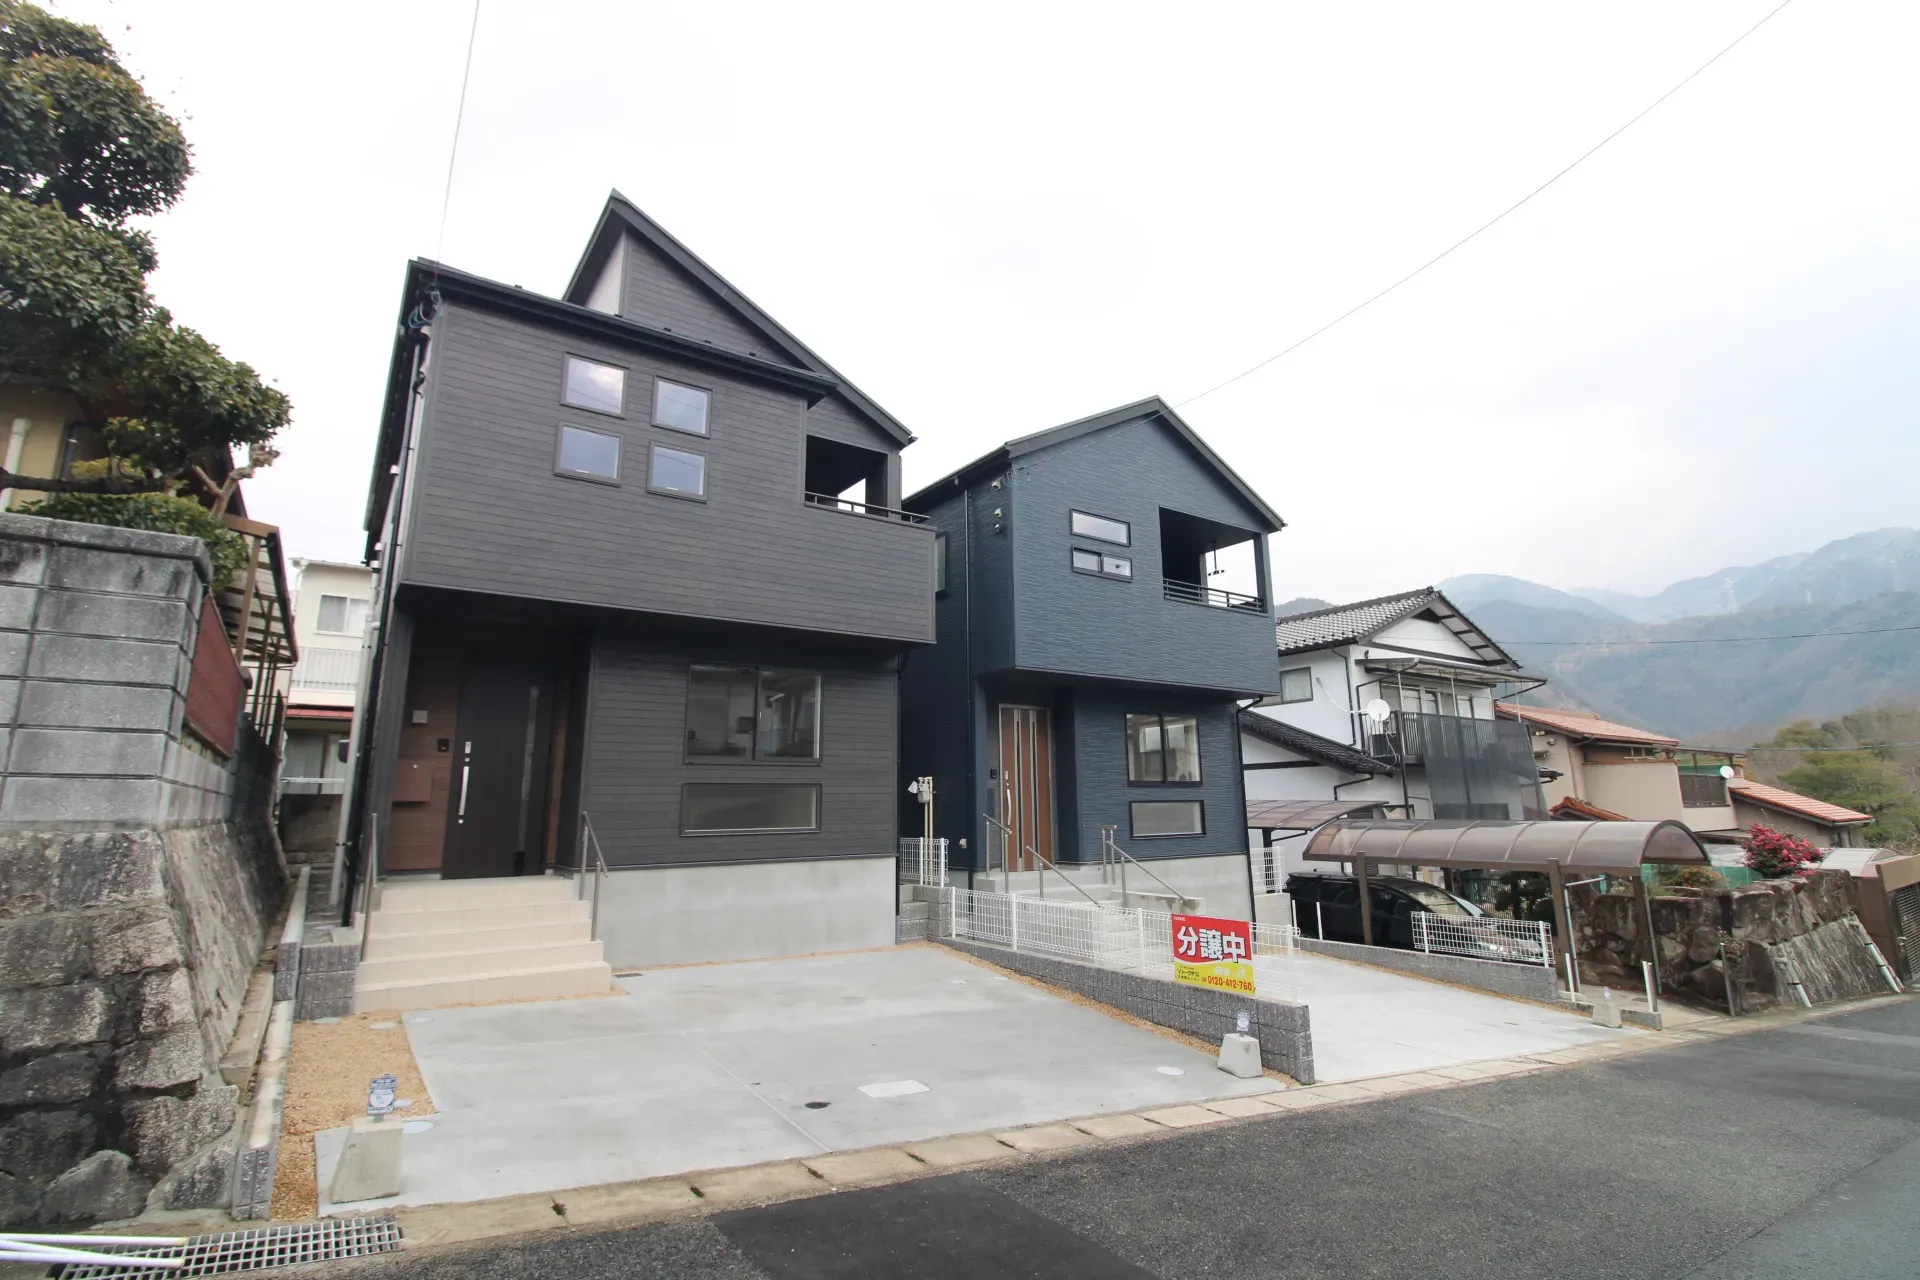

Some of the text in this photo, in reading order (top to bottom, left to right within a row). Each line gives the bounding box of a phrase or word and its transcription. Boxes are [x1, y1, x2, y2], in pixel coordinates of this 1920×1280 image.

[1177, 926, 1246, 963] 分譲中
[1208, 975, 1253, 991] 0120-412-760
